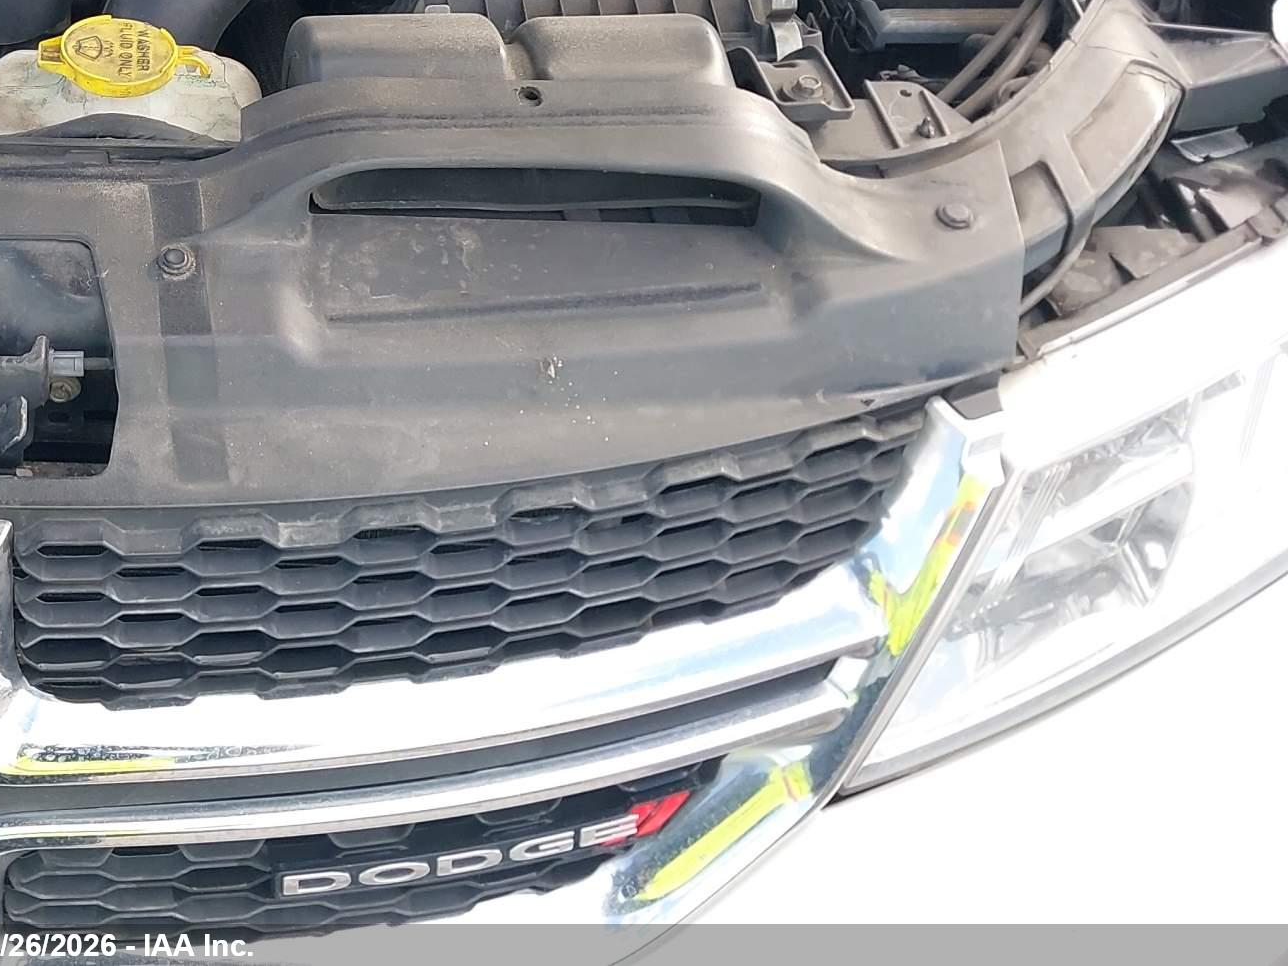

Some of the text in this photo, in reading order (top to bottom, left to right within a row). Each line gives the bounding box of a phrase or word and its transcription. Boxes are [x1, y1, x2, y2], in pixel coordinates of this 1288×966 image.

[118, 22, 133, 79] FLUID ONLY
[136, 30, 151, 72] WASHER
[281, 813, 640, 897] DODGE
